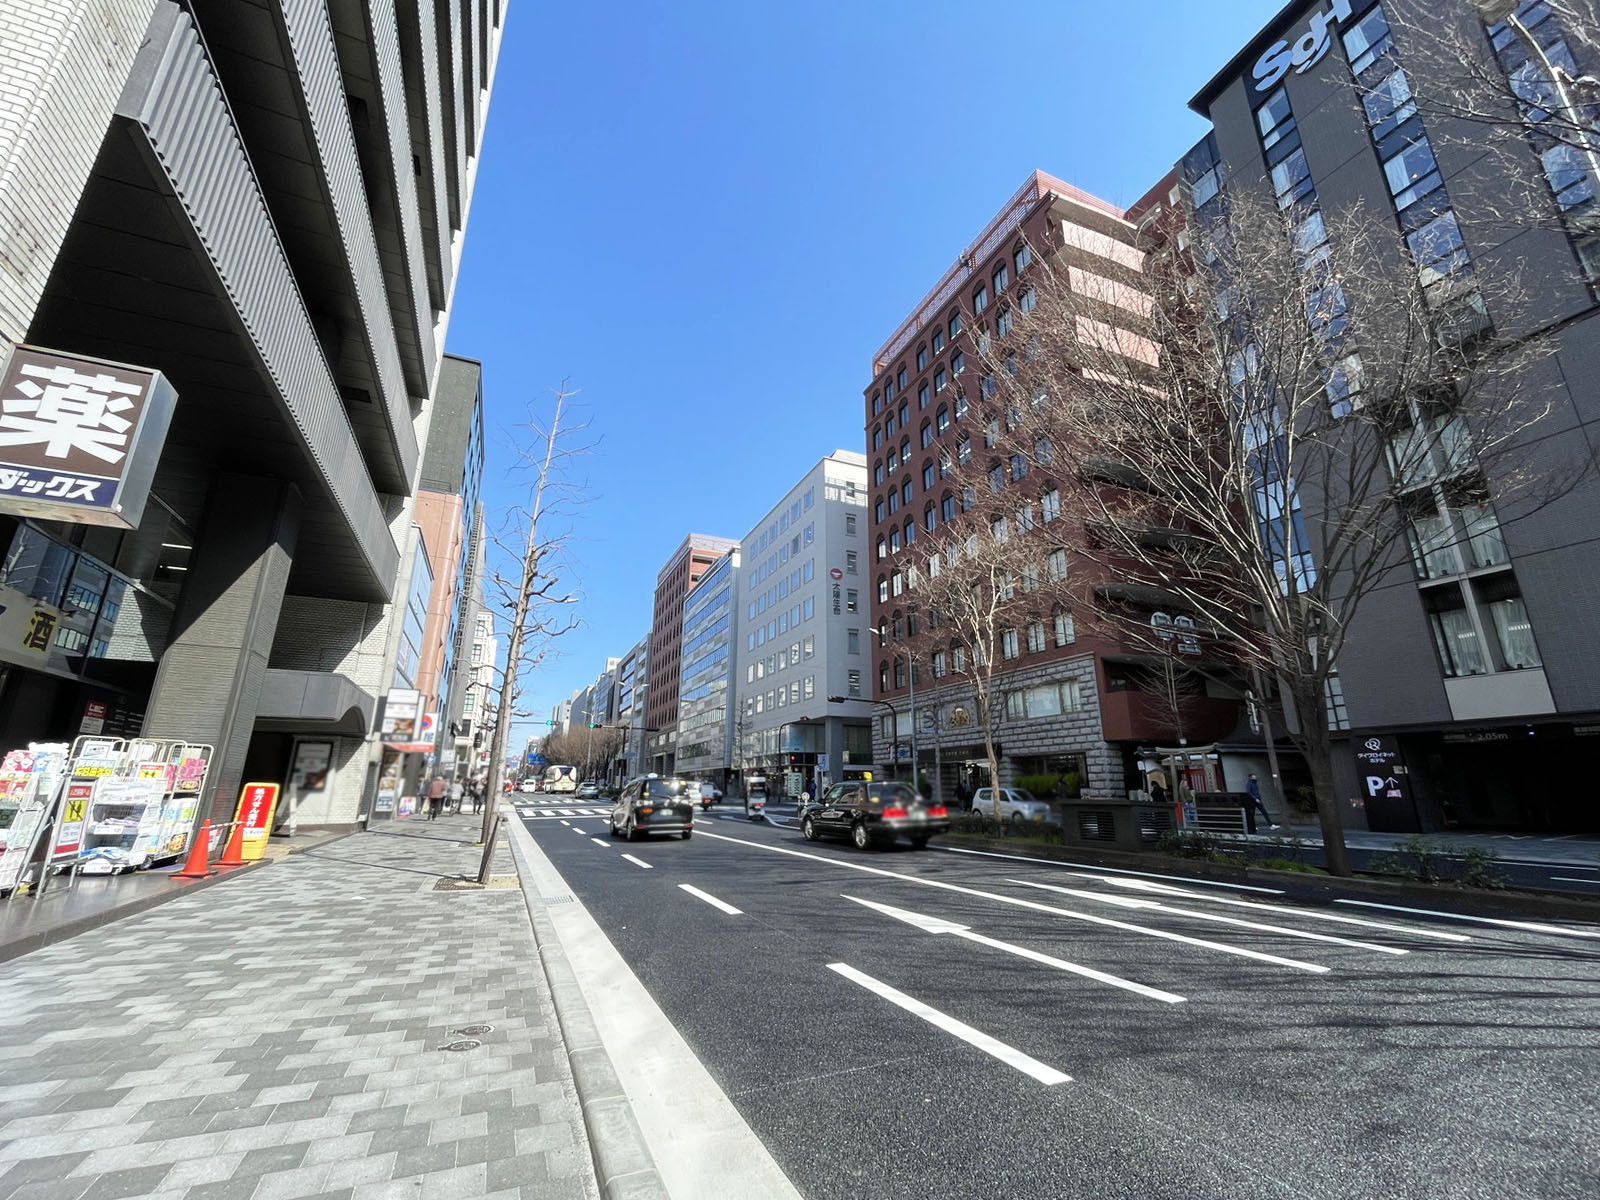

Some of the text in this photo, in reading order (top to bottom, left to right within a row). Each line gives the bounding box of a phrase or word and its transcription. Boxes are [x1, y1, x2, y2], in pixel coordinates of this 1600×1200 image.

[0, 364, 142, 464] 薬
[0, 468, 102, 501] ダックス
[23, 610, 57, 652] 酒
[1366, 775, 1385, 797] P
